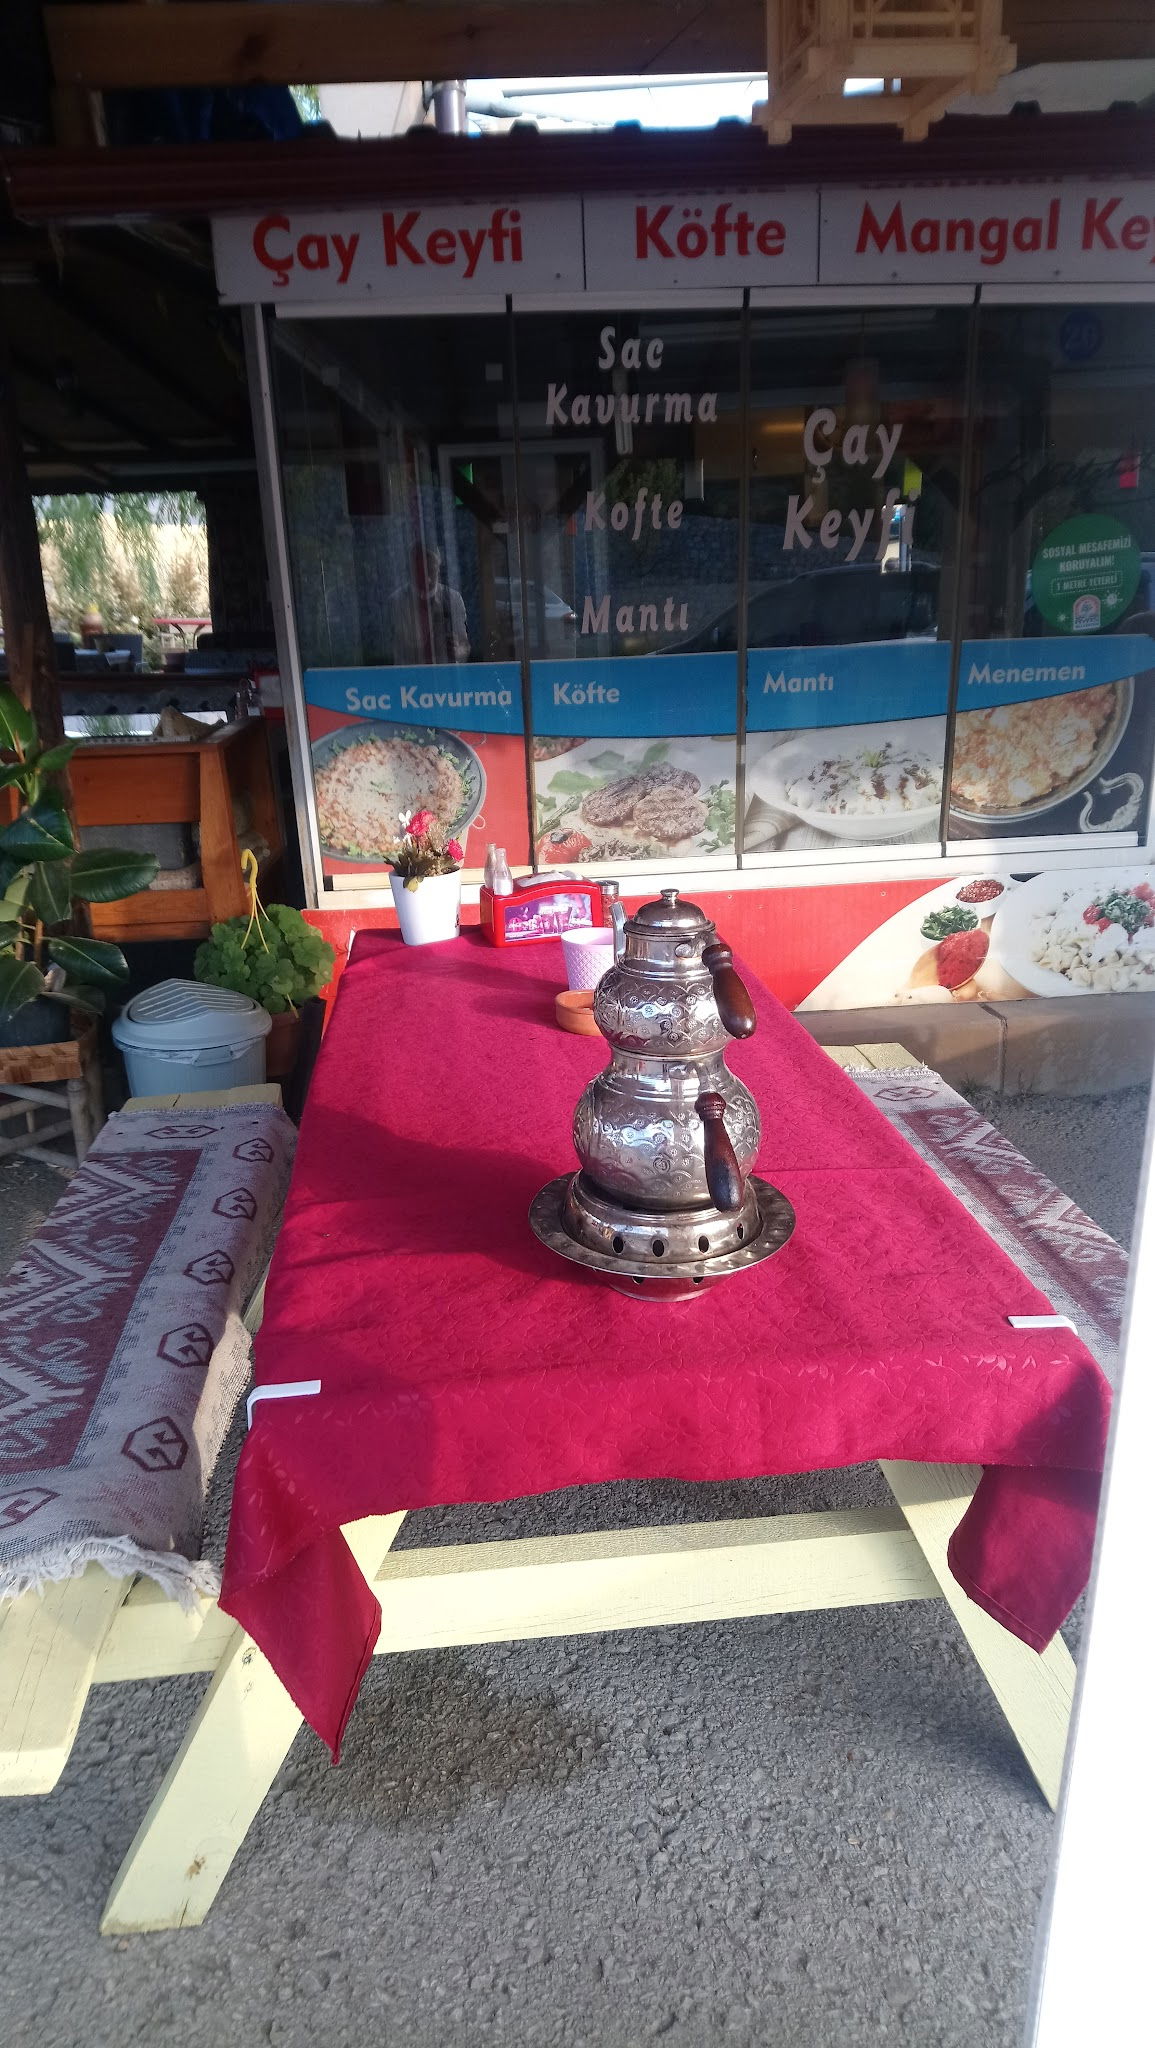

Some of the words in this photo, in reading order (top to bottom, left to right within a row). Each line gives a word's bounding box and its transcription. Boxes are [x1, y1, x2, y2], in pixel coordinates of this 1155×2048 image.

[252, 214, 360, 287] Çay
[382, 208, 524, 279] Keyfi
[634, 202, 787, 260] Köfte
[855, 198, 1061, 265] Mangal
[1082, 197, 1155, 264] Ke
[598, 325, 664, 371] Sac
[546, 383, 719, 426] Kavurma
[804, 408, 903, 484] Çay
[584, 487, 684, 541] Kofte
[782, 487, 922, 562] Keyfi
[1042, 543, 1077, 559] SOSYAL
[1063, 579, 1089, 590] METRE
[581, 594, 689, 634] Mantı
[553, 680, 621, 706] Köfte
[763, 670, 834, 694] Mantı
[967, 663, 1086, 686] Menemen
[345, 687, 391, 712] Sac
[400, 686, 512, 710] Kavurma
